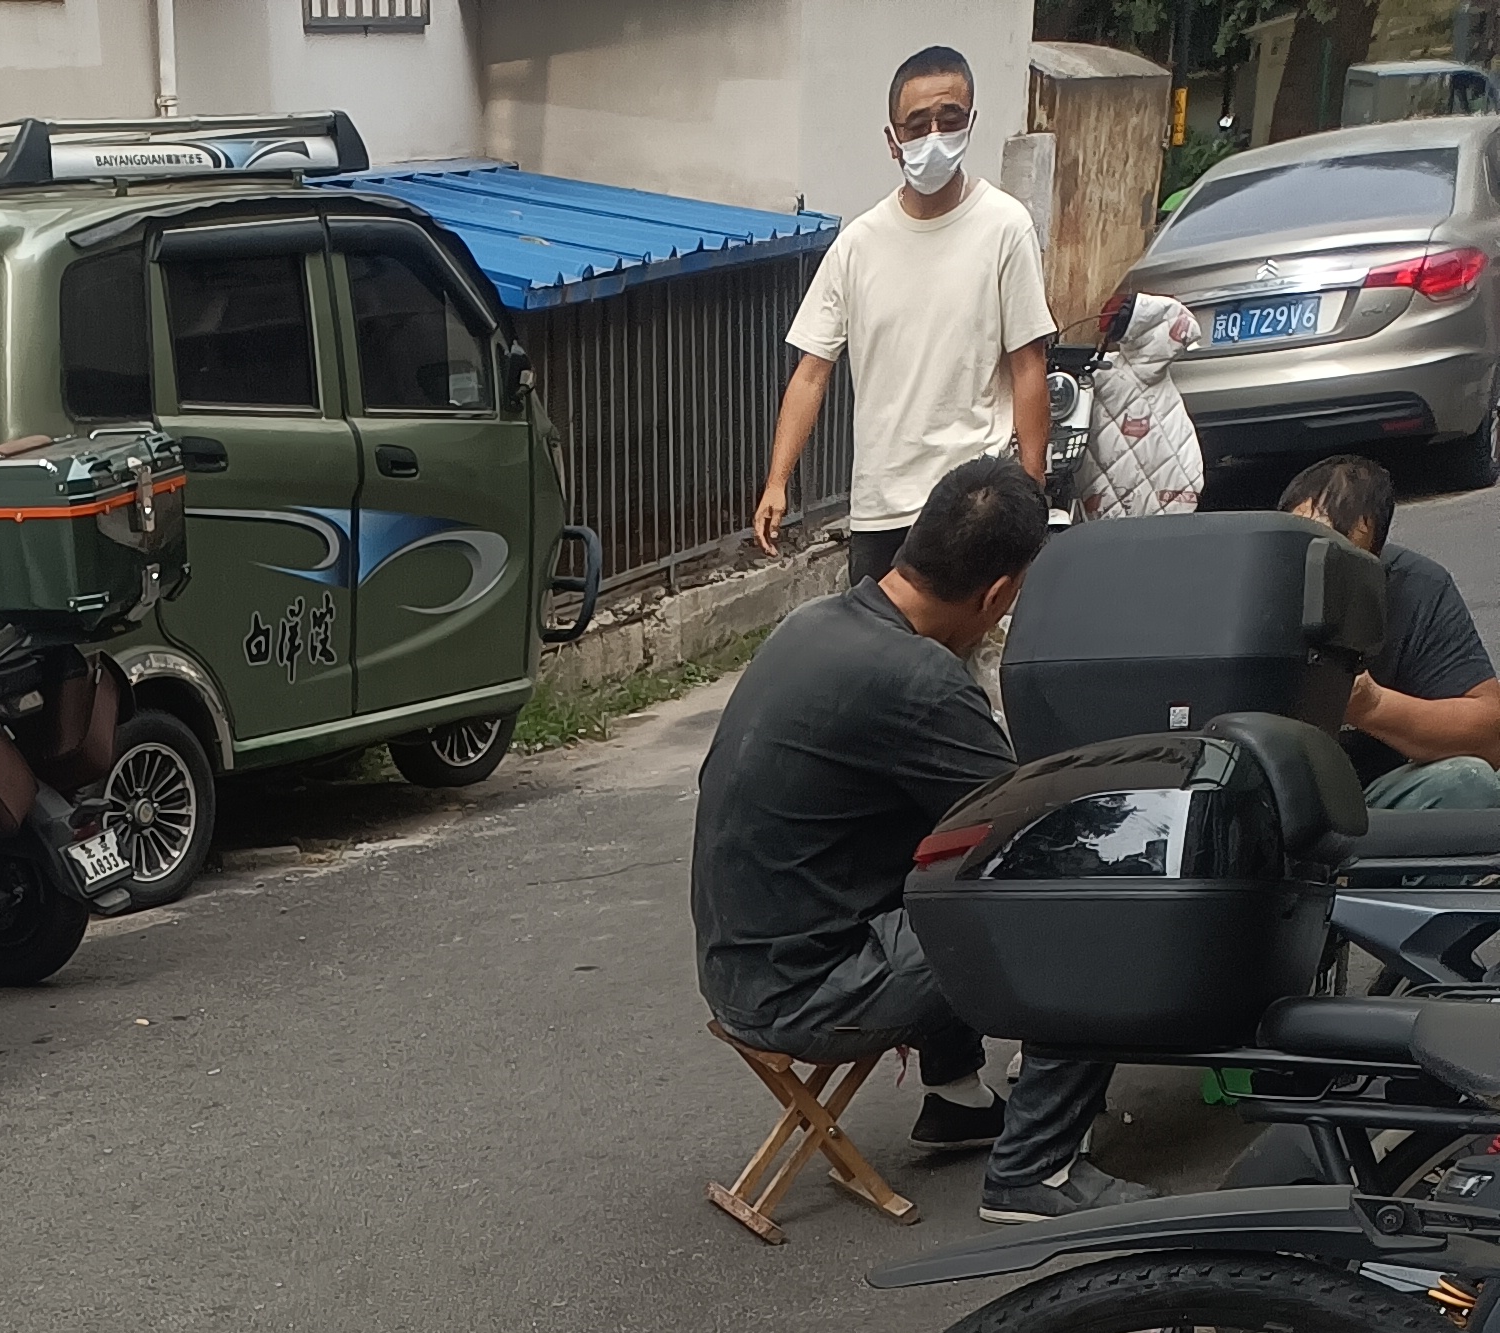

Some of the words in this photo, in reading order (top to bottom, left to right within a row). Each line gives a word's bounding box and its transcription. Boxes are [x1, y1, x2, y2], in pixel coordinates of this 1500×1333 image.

[95, 154, 165, 167] BAIYANGDIAN
[243, 590, 338, 684] 白洋淀
[84, 852, 127, 880] LA833
